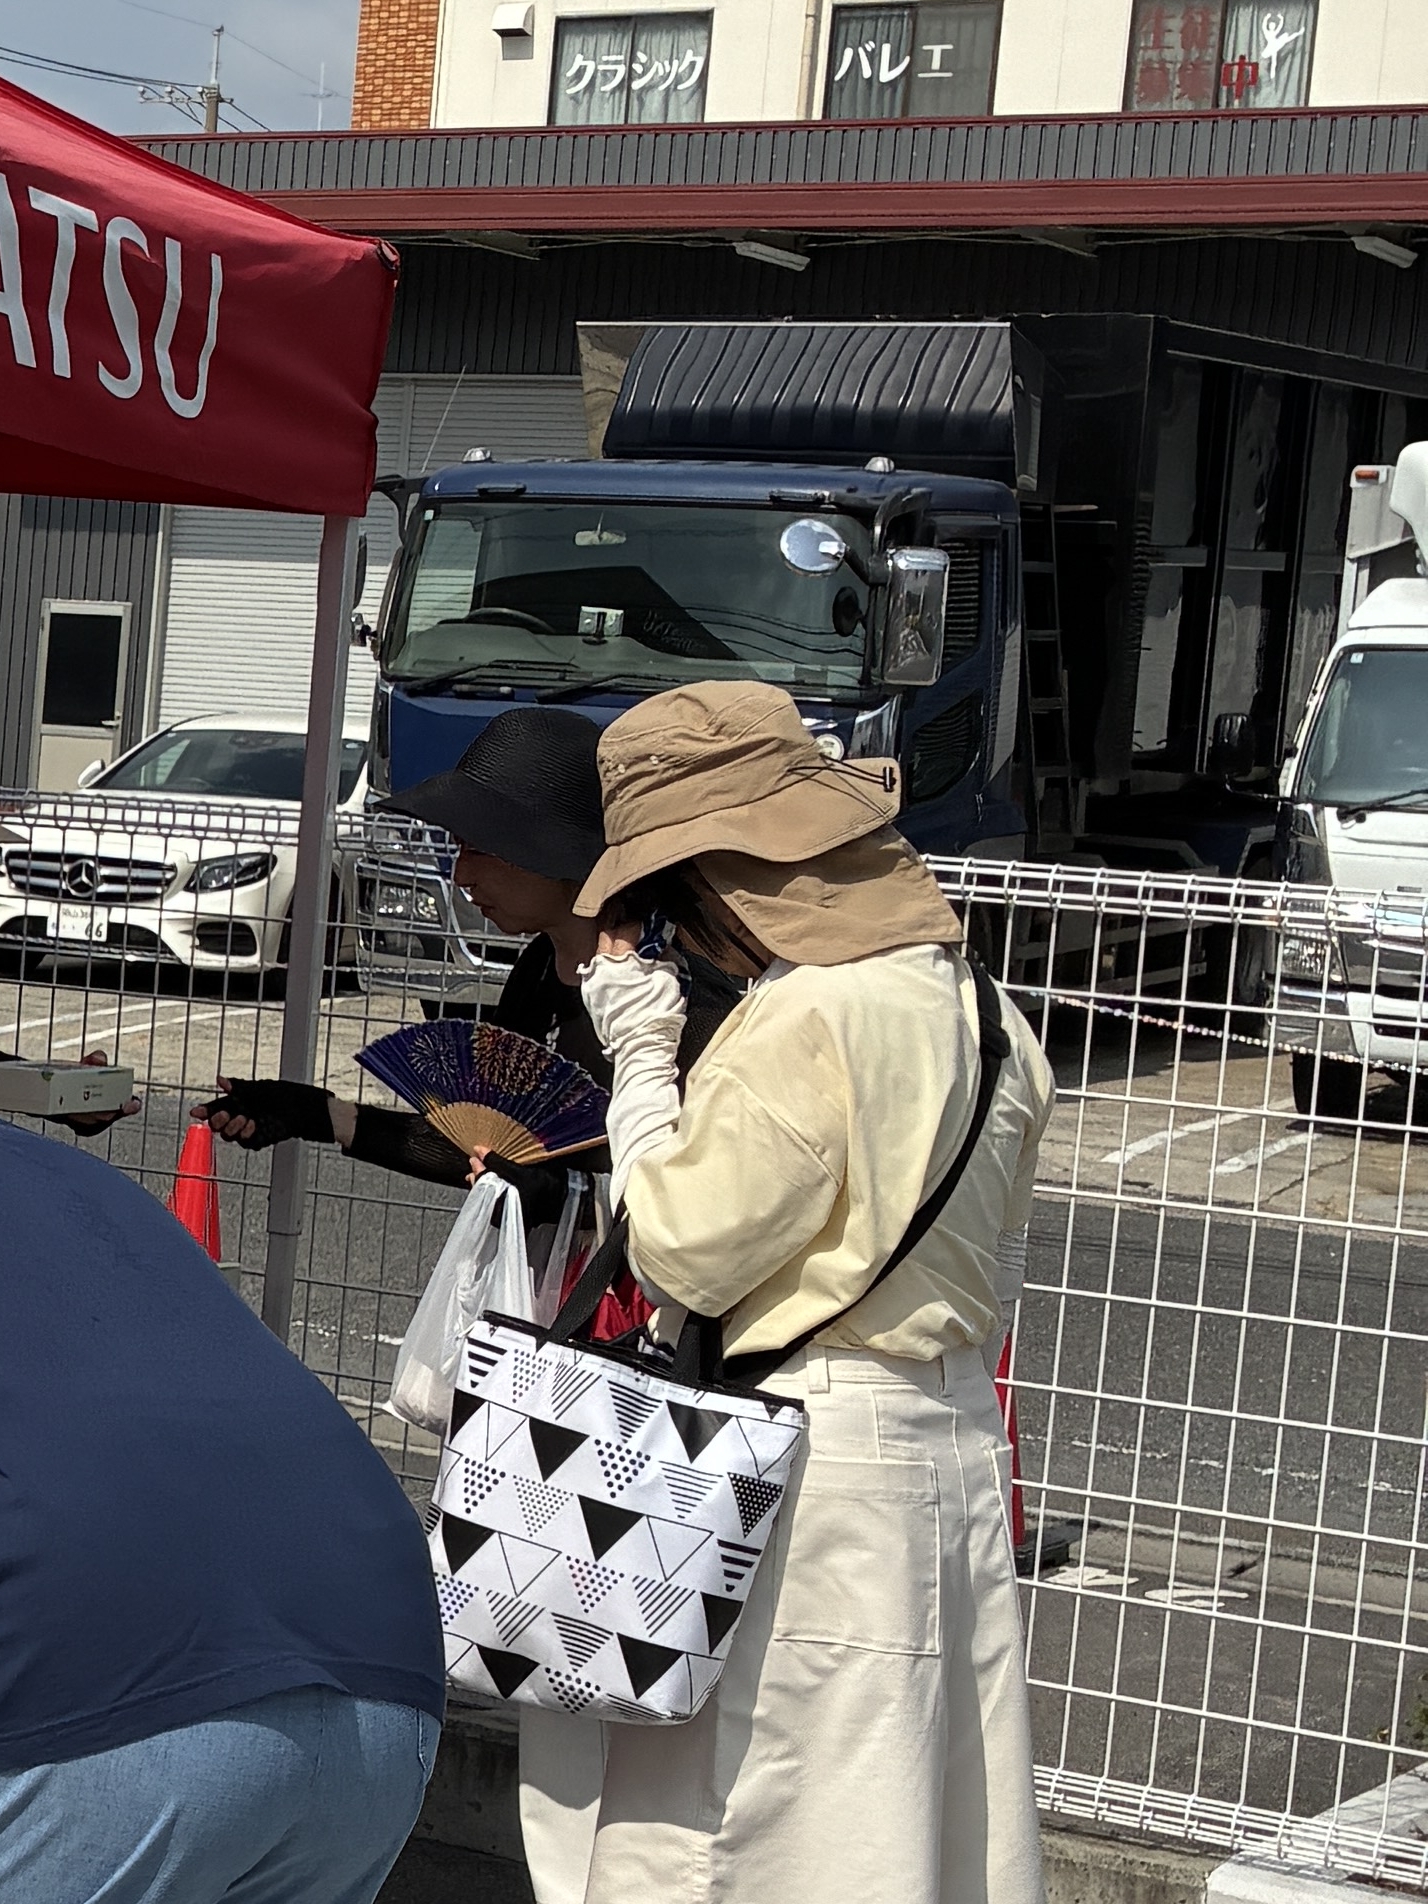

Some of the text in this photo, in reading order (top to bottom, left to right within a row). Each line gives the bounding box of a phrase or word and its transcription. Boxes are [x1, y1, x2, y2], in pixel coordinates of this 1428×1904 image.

[565, 40, 954, 95] クラシック バレエ
